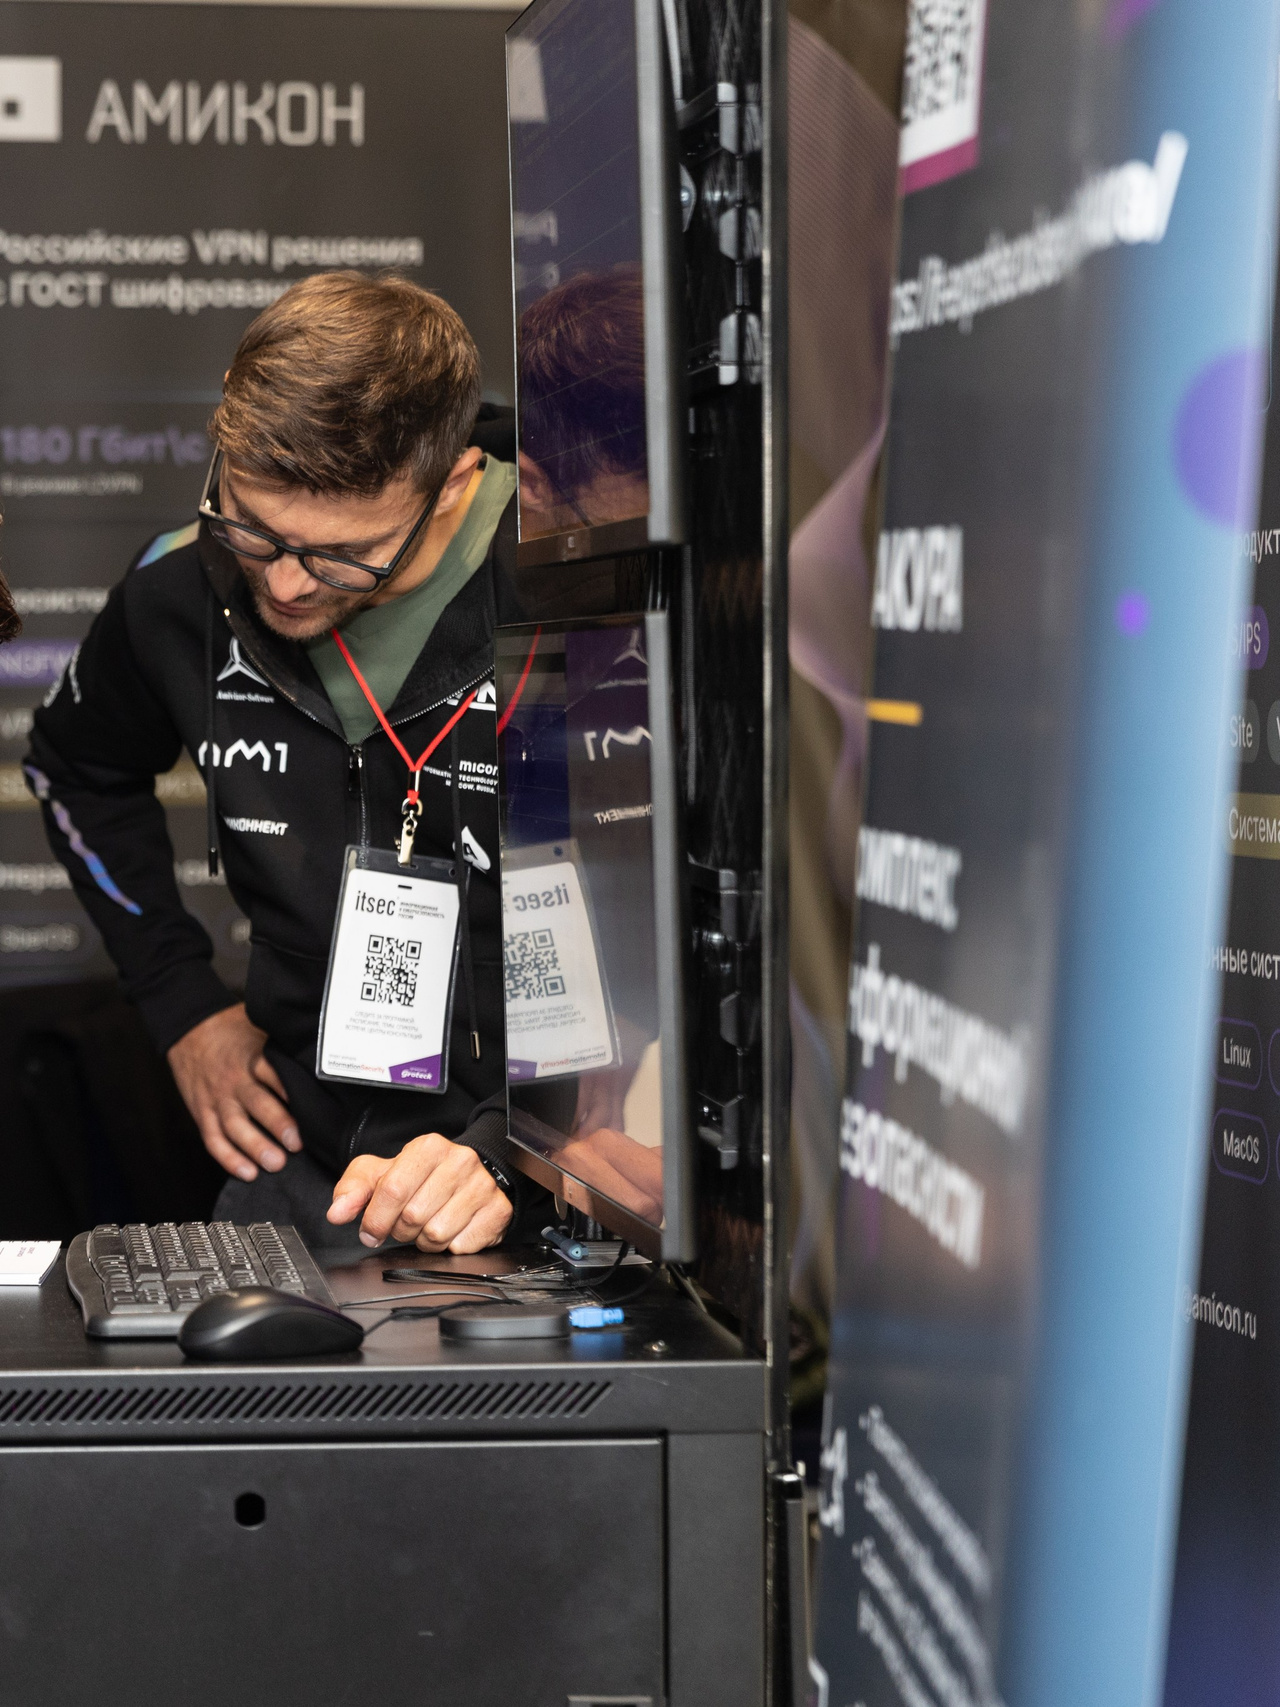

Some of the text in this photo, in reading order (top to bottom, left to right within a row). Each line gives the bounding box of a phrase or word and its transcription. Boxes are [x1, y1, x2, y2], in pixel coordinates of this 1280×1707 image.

[85, 77, 366, 147] АМИКОН
[192, 230, 269, 266] VPN
[272, 235, 425, 270] решения
[9, 272, 108, 308] ГОСТ
[110, 273, 291, 315] шифрован
[355, 890, 396, 916] itsec
[1223, 1037, 1251, 1068] Linux
[1223, 1129, 1260, 1165] MacOS
